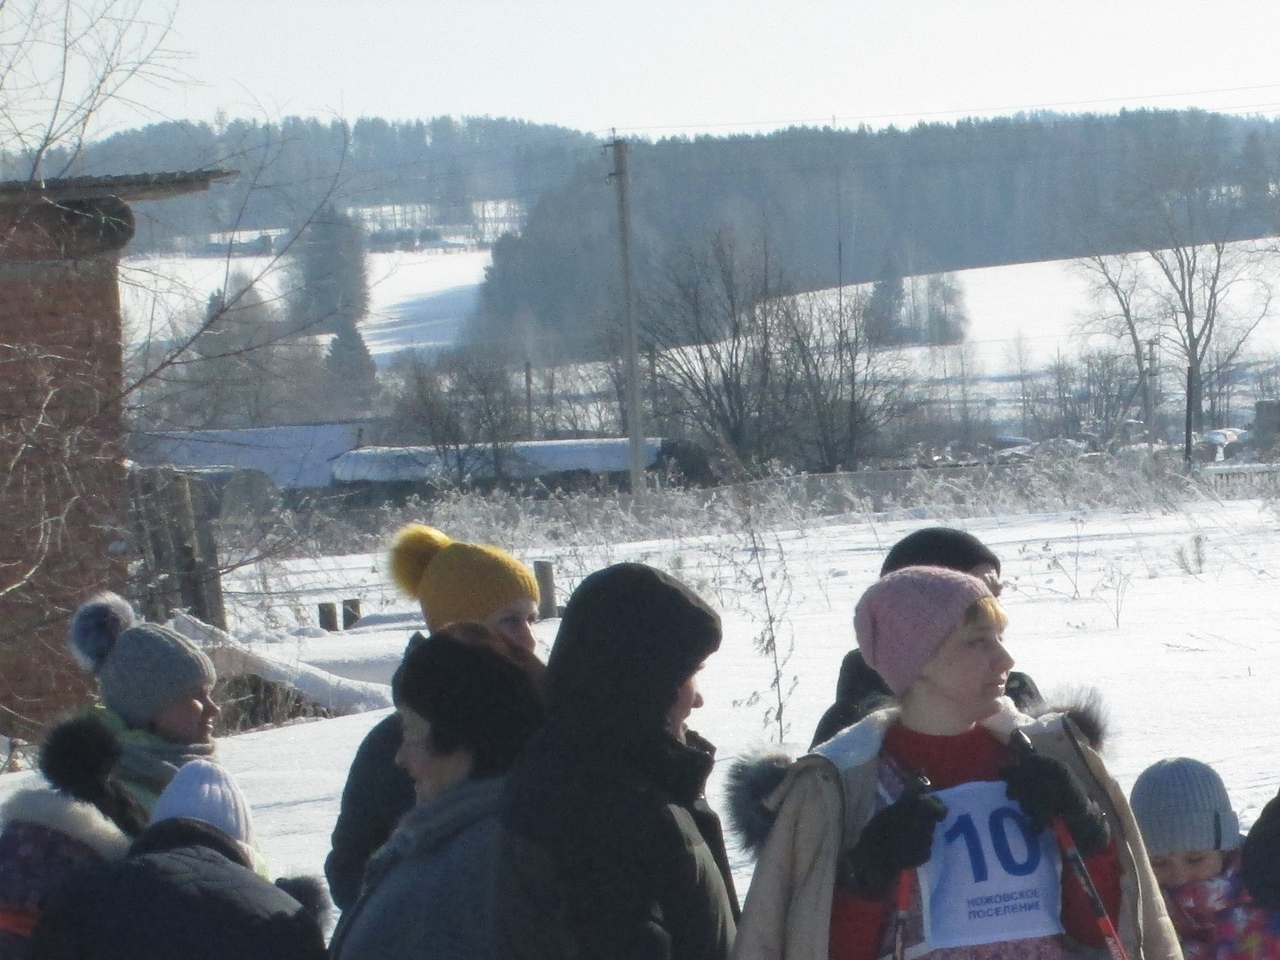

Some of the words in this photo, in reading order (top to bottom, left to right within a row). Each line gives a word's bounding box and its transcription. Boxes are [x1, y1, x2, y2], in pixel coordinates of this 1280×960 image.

[943, 806, 1041, 883] 10
[967, 889, 1039, 908] НОЖОВСКОЕ
[968, 900, 1041, 919] ПОСЕЛЕНИЕ
